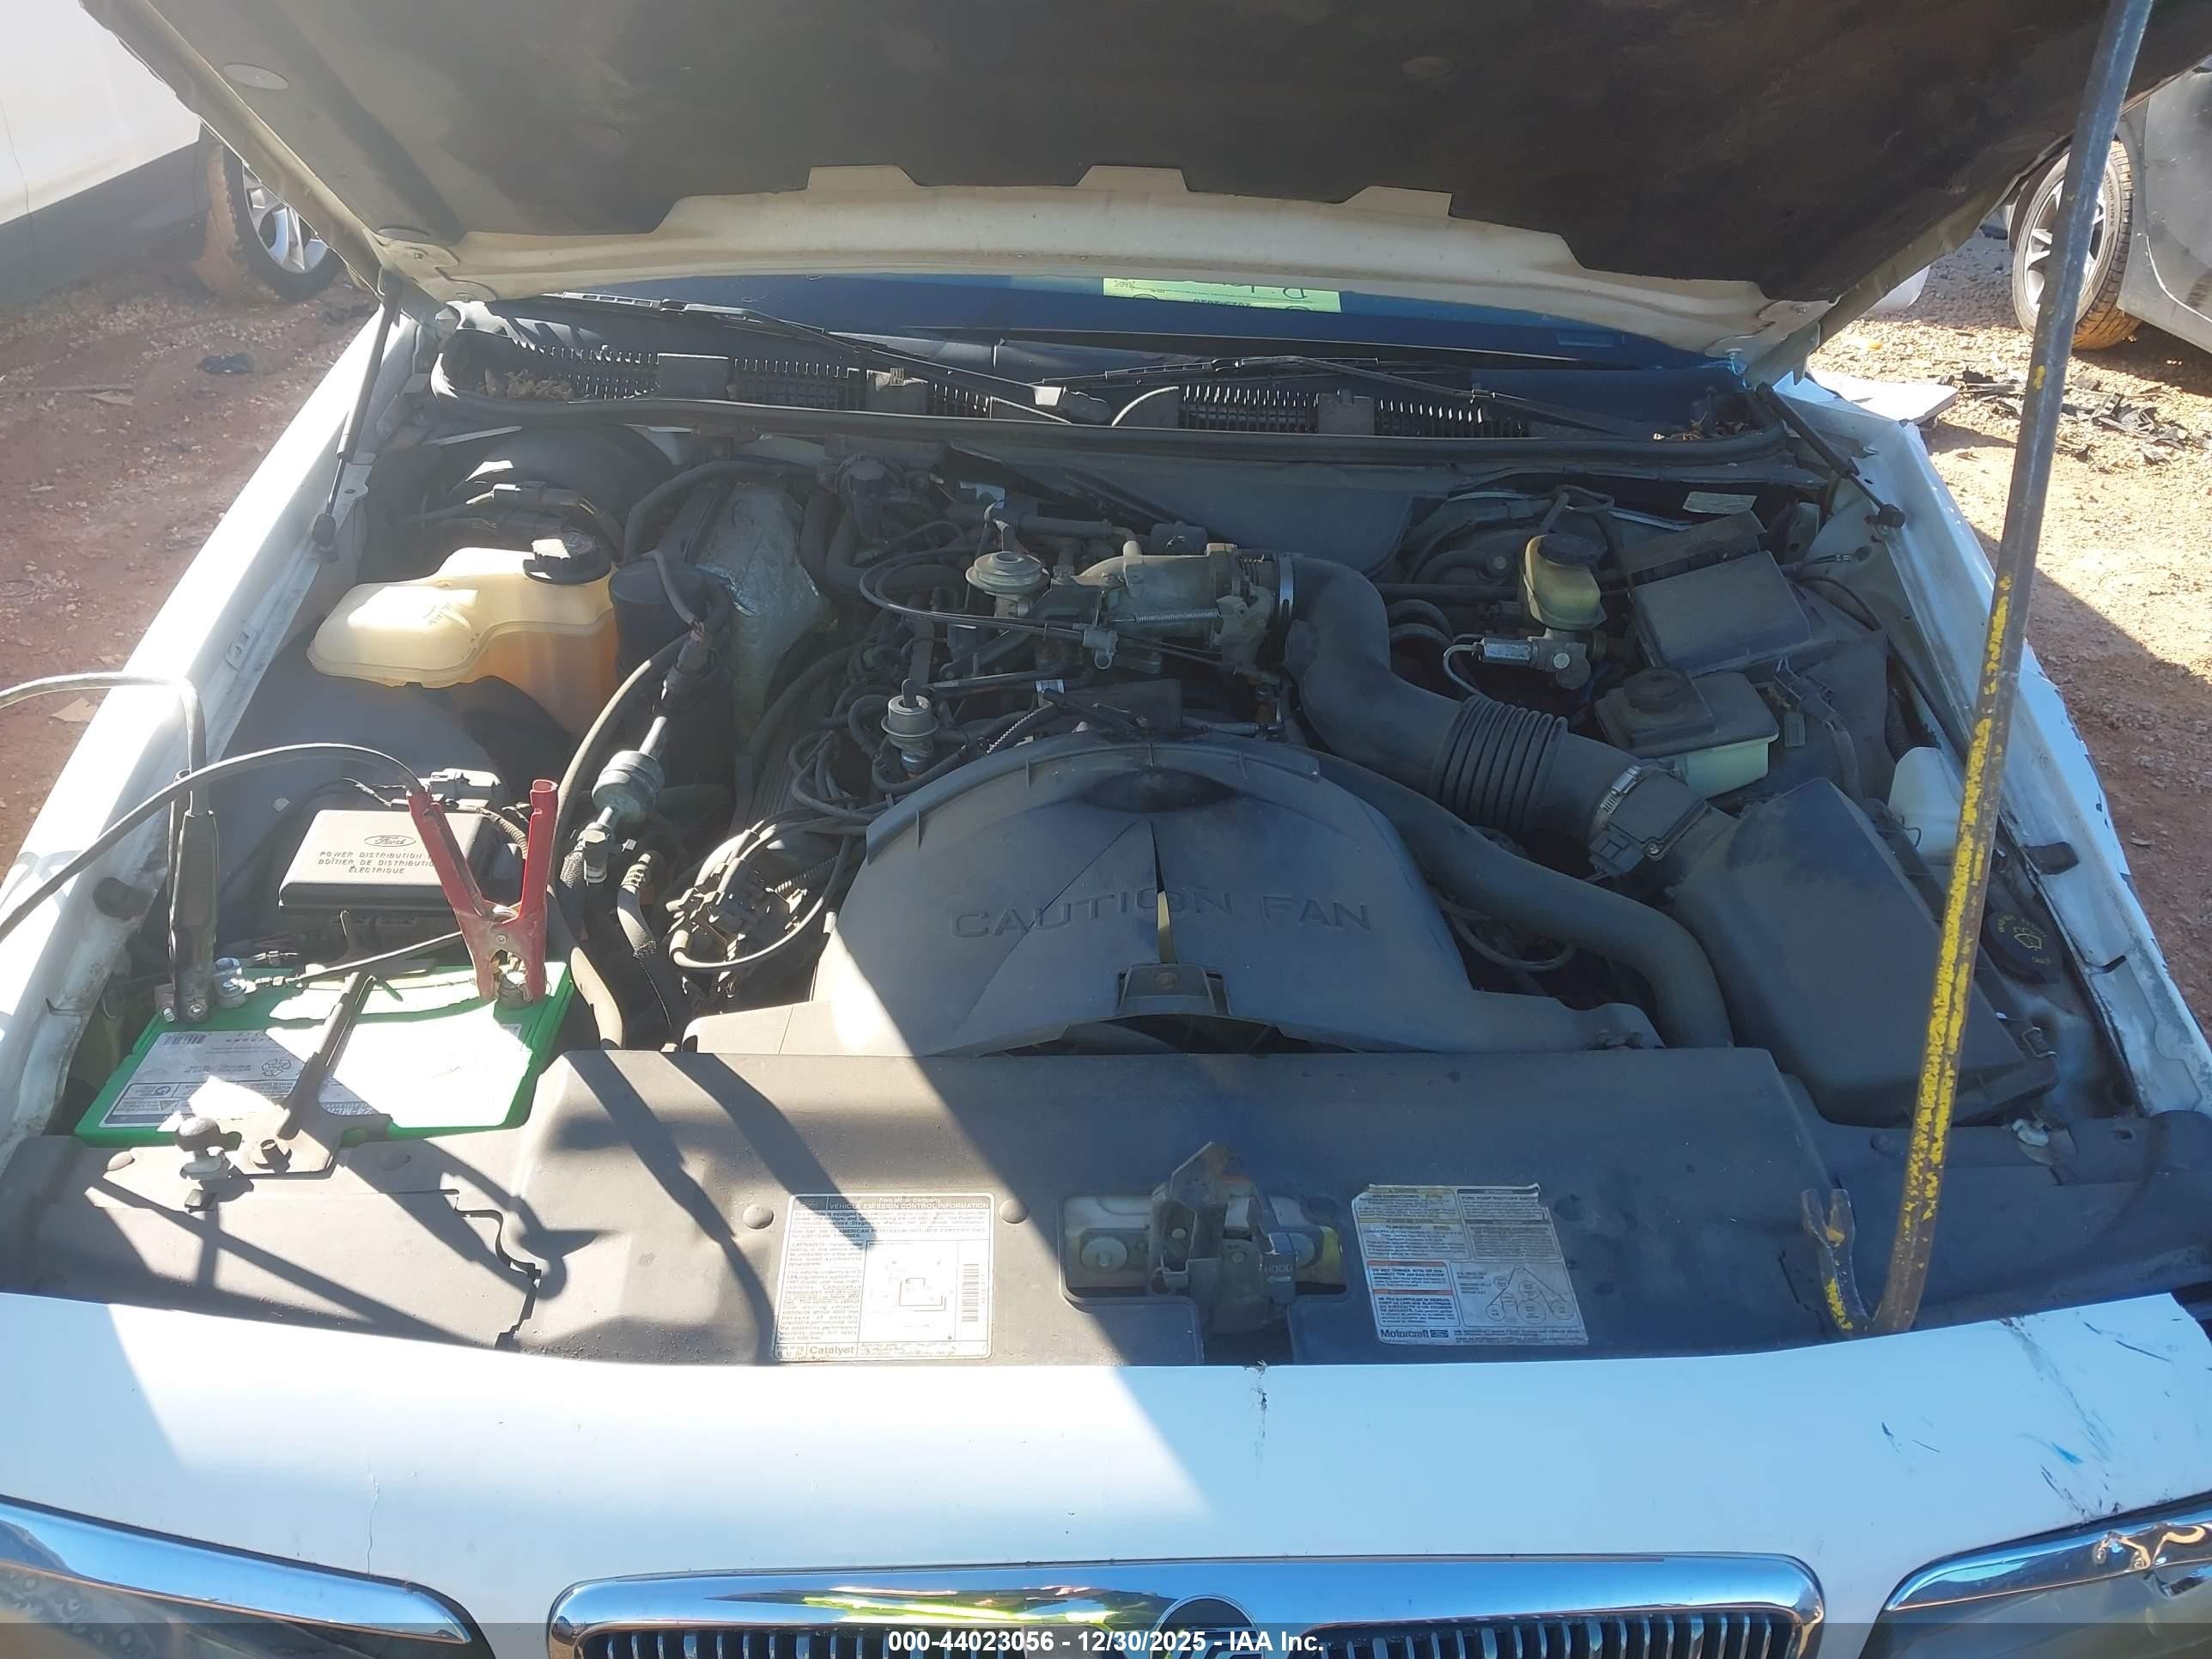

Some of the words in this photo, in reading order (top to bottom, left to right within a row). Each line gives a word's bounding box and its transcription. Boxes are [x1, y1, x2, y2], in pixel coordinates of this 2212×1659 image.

[349, 865, 405, 874] ÉLECTRIQUE
[951, 885, 1234, 939] CAUTION
[1260, 894, 1375, 933] FAN
[901, 1201, 937, 1210] CONTROL
[938, 1201, 989, 1210] INFORMATION
[1380, 1329, 1430, 1339] Motorcraft
[809, 1346, 854, 1356] Catalyst
